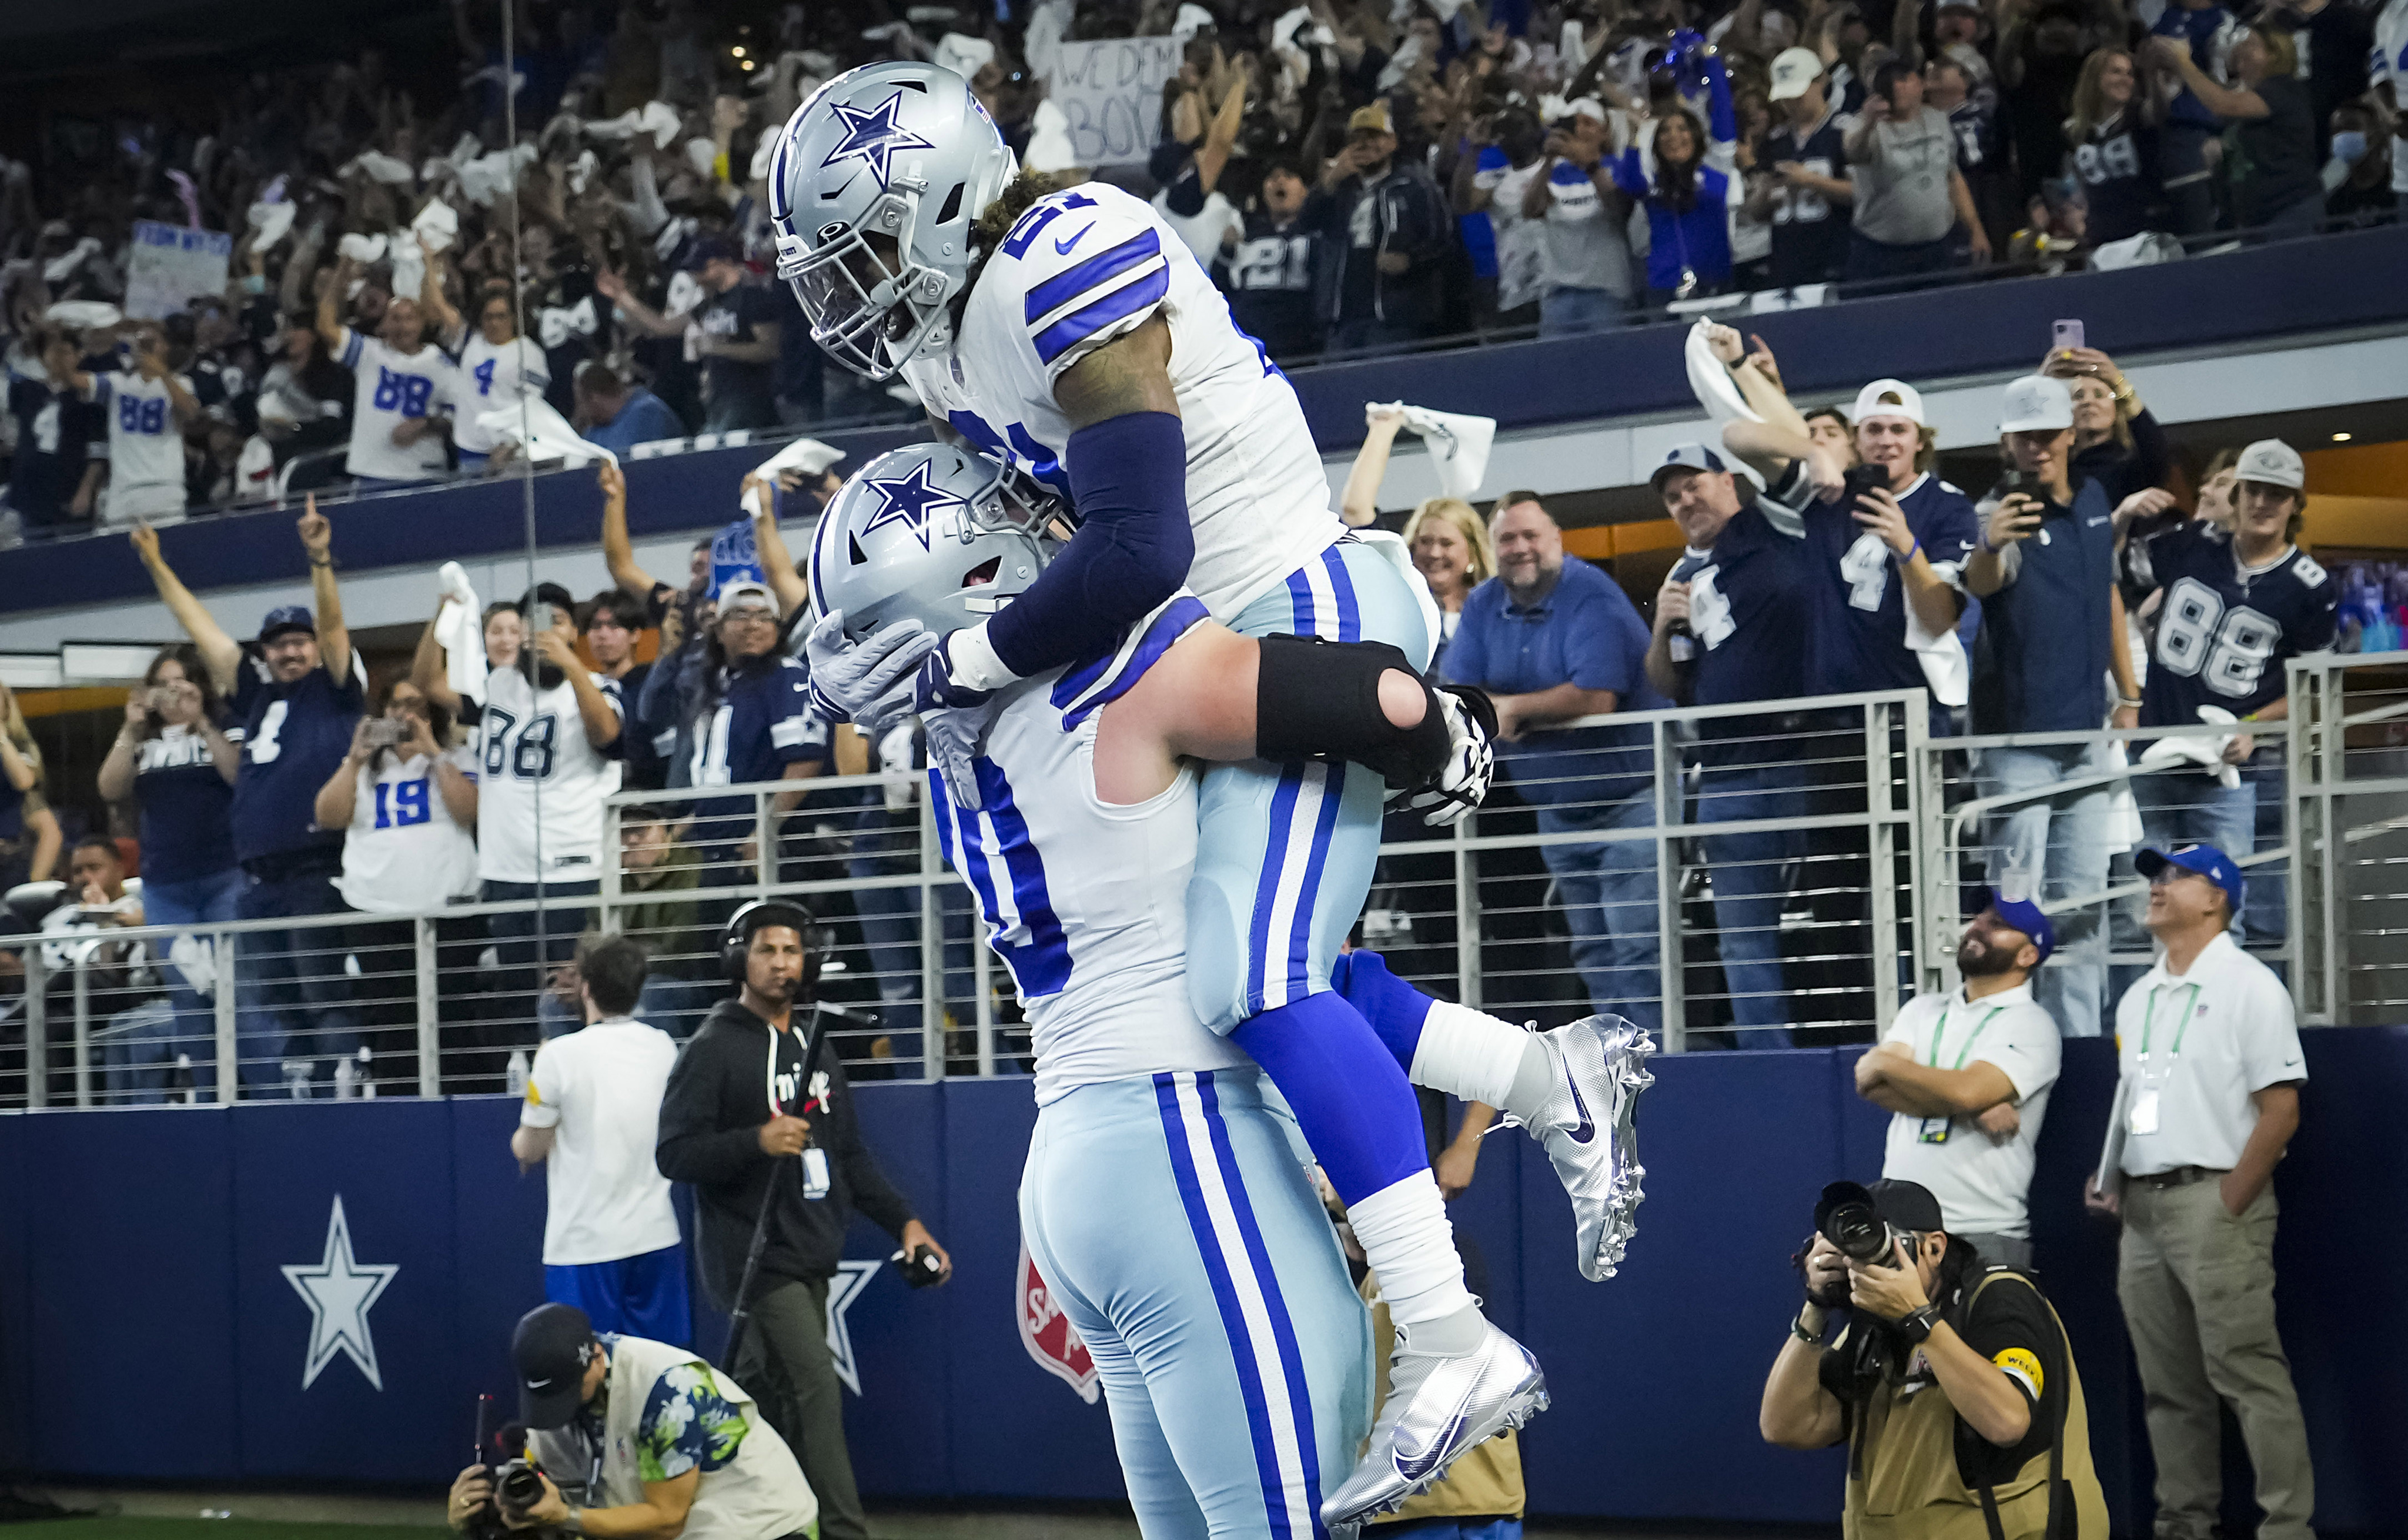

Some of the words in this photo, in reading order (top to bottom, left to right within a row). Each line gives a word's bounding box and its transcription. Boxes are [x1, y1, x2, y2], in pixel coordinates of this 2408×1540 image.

[1243, 236, 1310, 290] 21
[374, 365, 433, 418] 88
[473, 358, 496, 396] 4
[119, 395, 165, 434] 88
[1840, 532, 1892, 612] 4
[1688, 564, 1738, 652] 4
[2156, 576, 2283, 699] 88
[480, 706, 562, 782] 88
[375, 780, 431, 829] 19
